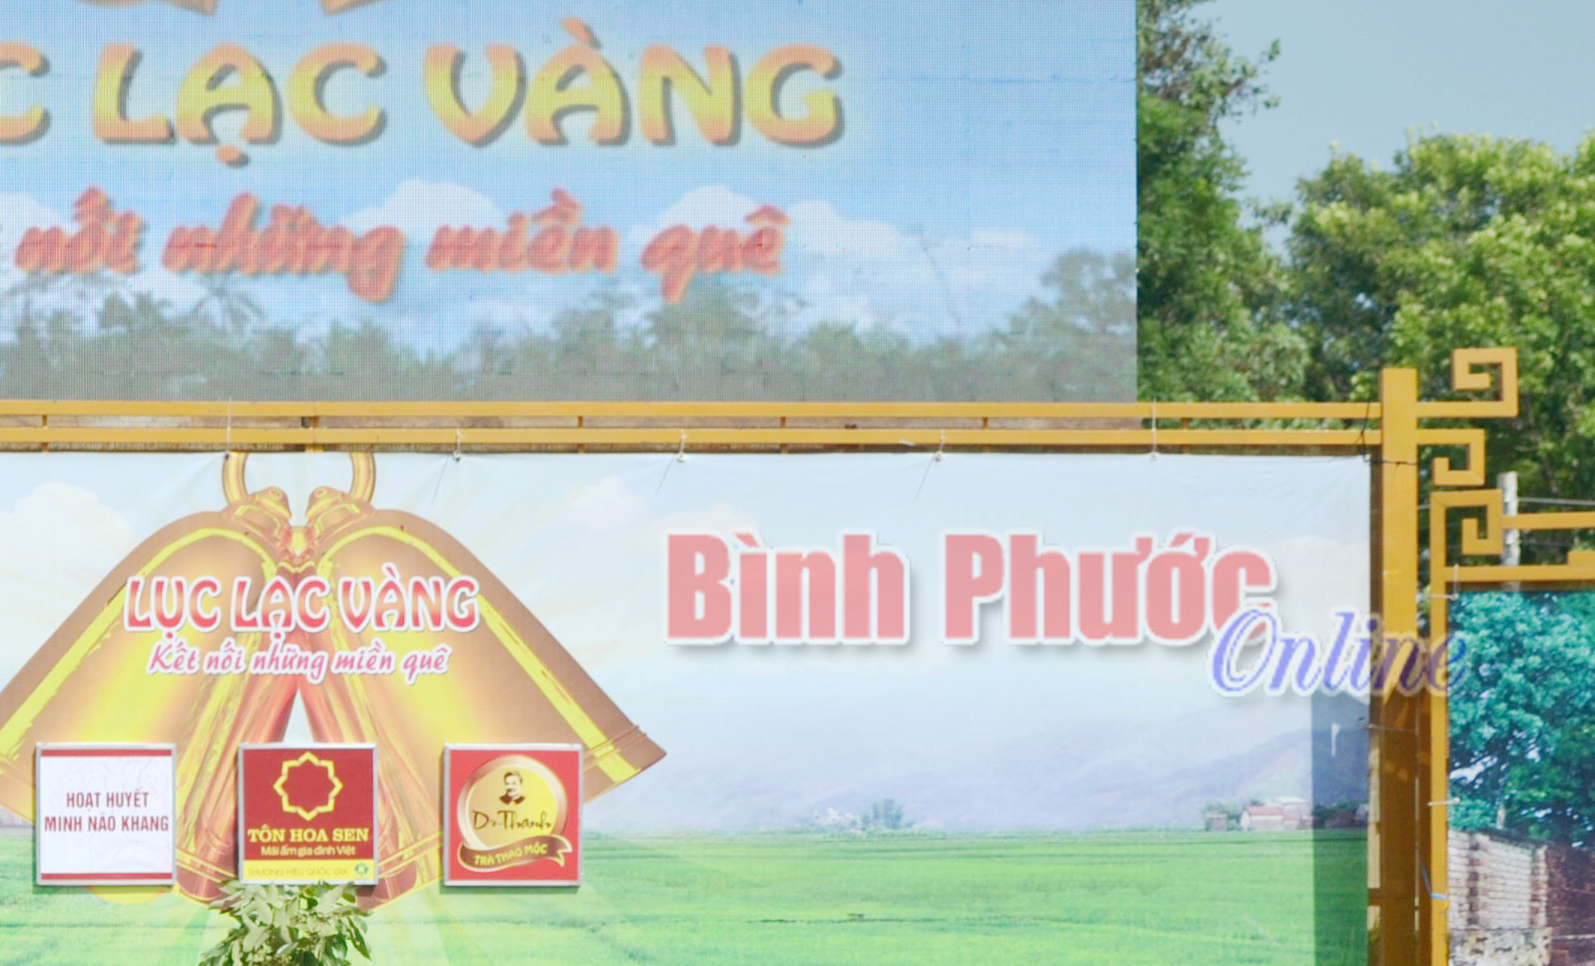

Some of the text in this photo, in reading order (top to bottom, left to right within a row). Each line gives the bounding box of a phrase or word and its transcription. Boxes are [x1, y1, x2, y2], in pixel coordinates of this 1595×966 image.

[92, 42, 387, 167] LẠC
[422, 17, 844, 148] VÀNG
[161, 191, 407, 303] những
[426, 187, 620, 274] miền
[639, 203, 791, 305] quê
[125, 564, 479, 640] LỤC LẠC VÀNG
[147, 639, 452, 683] Kết nối những miền quê
[66, 785, 149, 813] HOẠT HUYẾT
[44, 815, 83, 832] MINH
[121, 815, 169, 832] KHANG
[247, 823, 370, 843] TÔN HOA SEN
